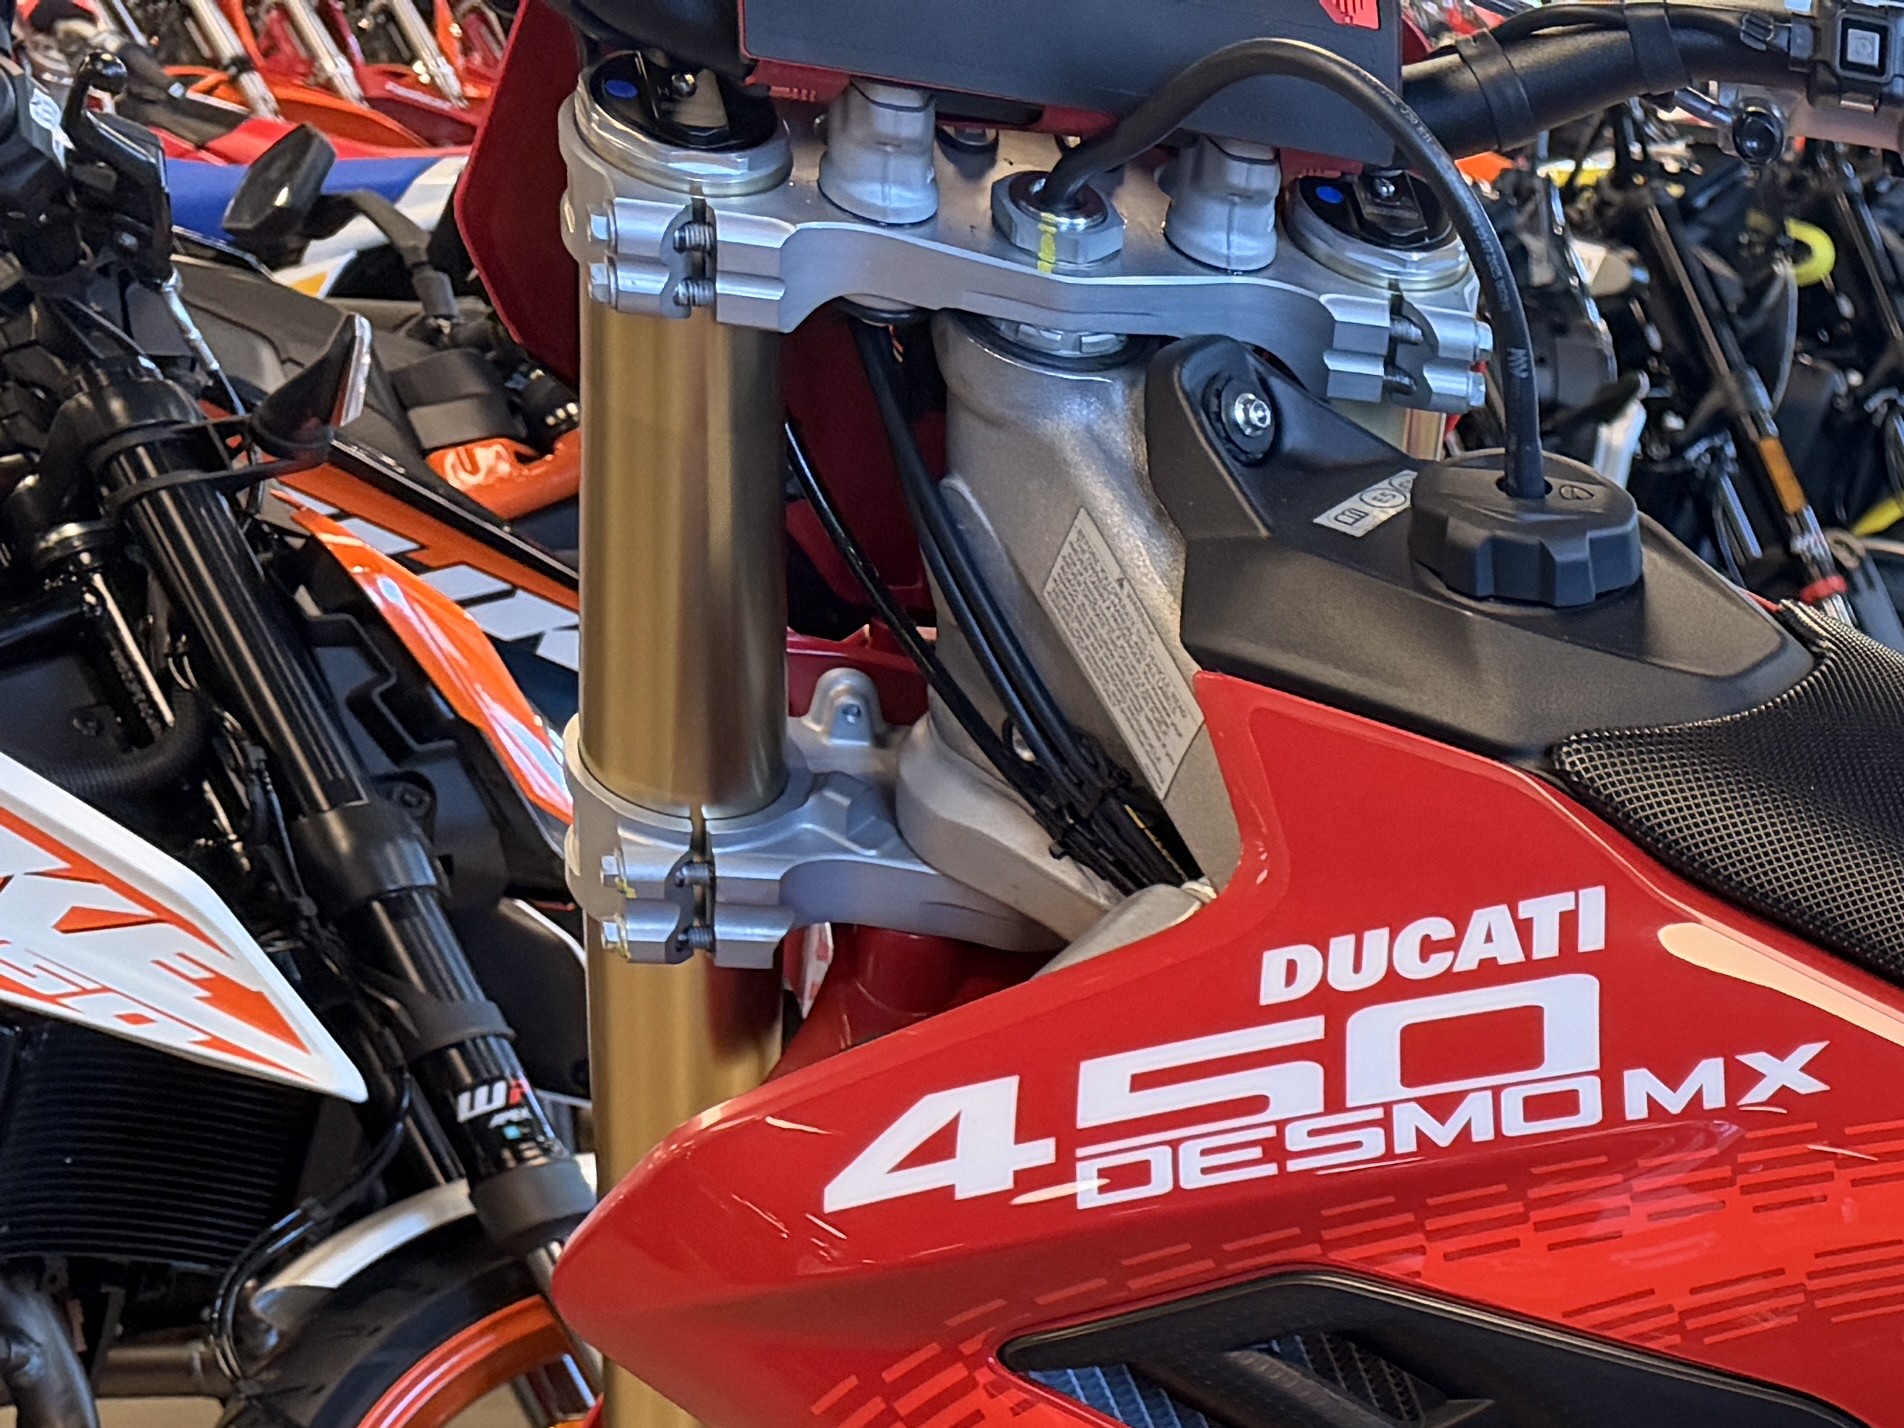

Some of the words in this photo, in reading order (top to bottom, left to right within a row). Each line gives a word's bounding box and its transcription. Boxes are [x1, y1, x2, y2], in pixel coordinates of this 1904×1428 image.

[1258, 884, 1607, 1007] DUCATI
[822, 972, 1603, 1214] 450
[1074, 1075, 1603, 1211] DESMO
[1623, 1040, 1832, 1122] MX
